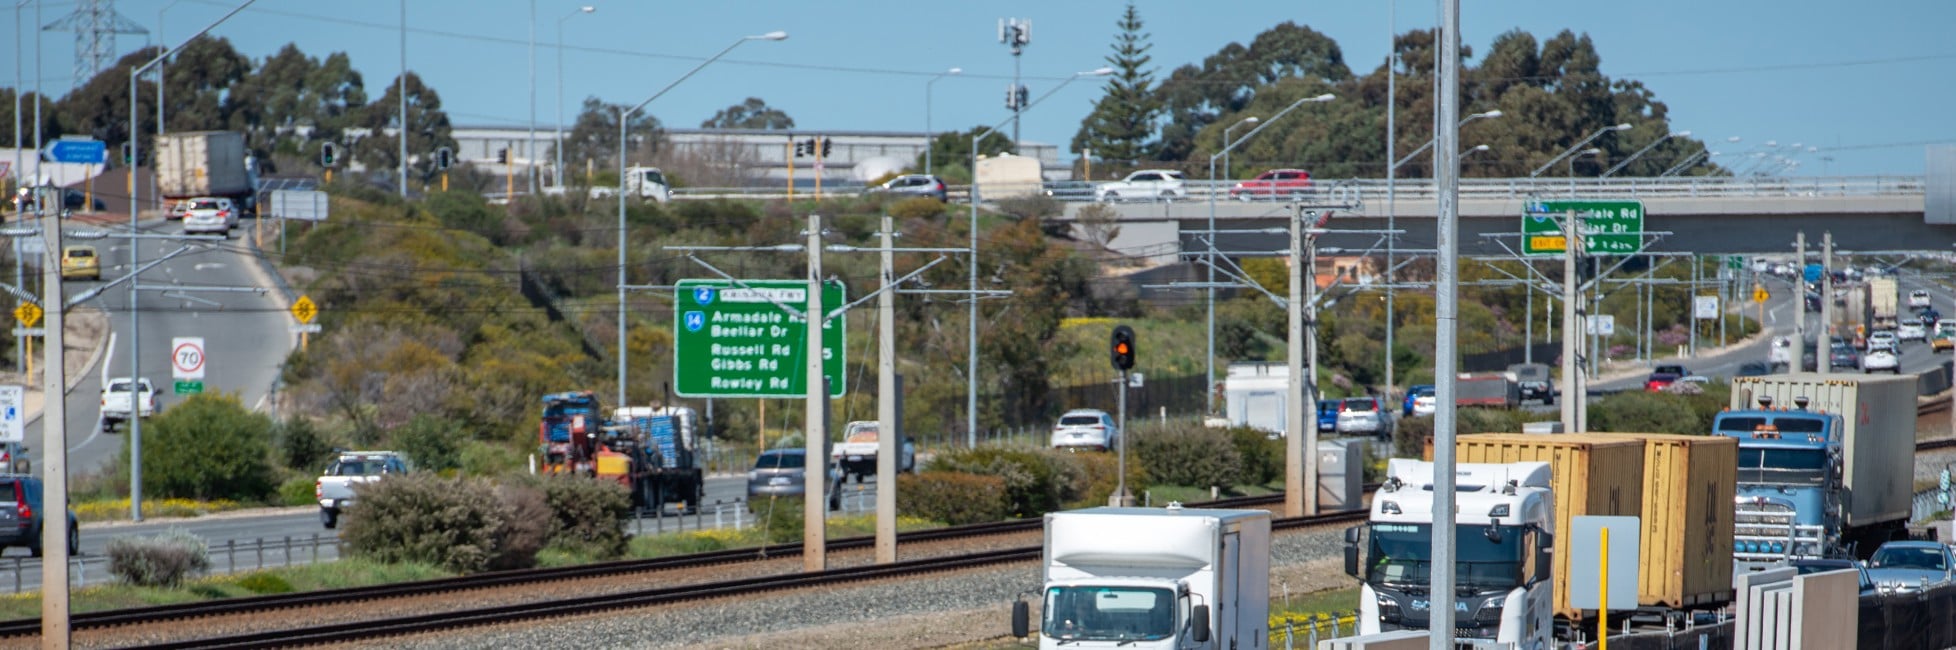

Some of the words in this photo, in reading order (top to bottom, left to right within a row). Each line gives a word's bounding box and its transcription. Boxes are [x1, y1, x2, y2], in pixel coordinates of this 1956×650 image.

[1620, 207, 1637, 219] Rd
[698, 288, 710, 301] 2
[687, 314, 700, 326] 14
[711, 311, 782, 323] Armadale
[710, 325, 764, 337] Beeliar
[770, 325, 788, 337] Dr
[710, 343, 764, 356] Russell
[771, 343, 791, 356] Rd
[180, 351, 199, 366] 70
[710, 358, 752, 371] Gibbs
[758, 358, 778, 371] Rd
[710, 376, 763, 391] Rowley
[769, 376, 789, 389] Rd
[1411, 599, 1469, 613] SCIA
